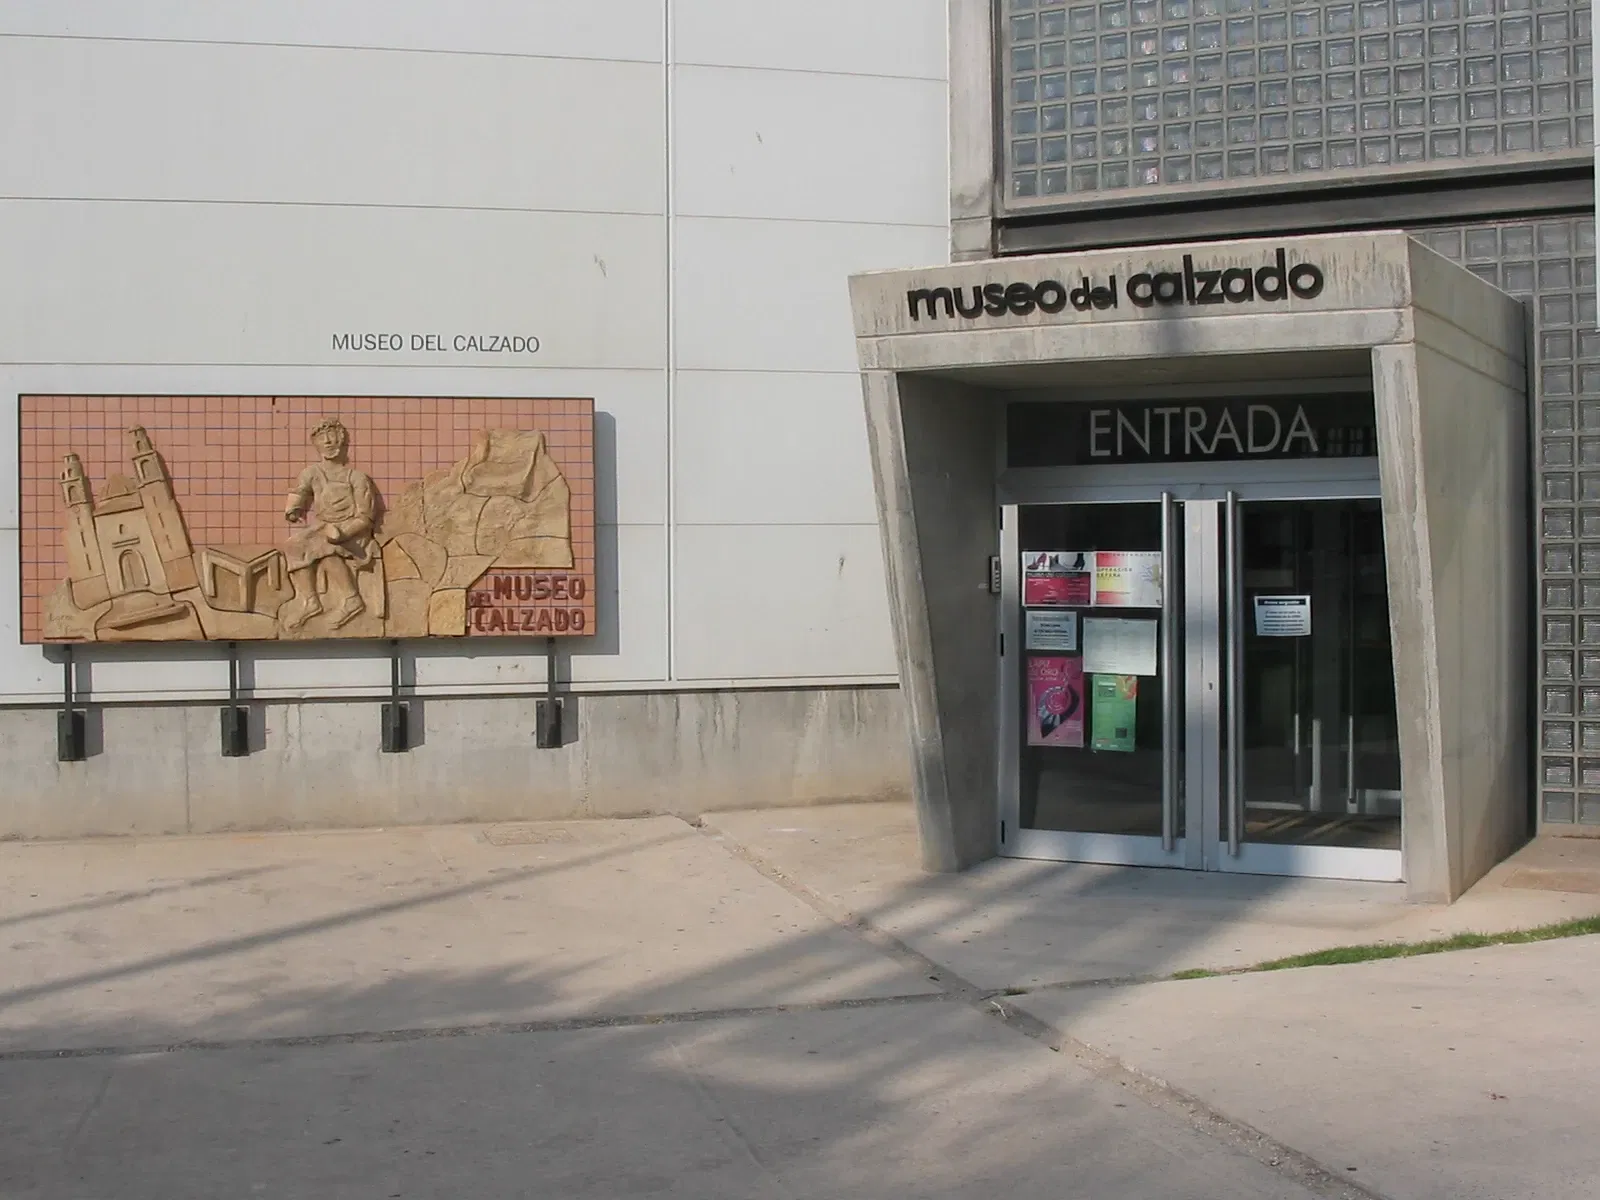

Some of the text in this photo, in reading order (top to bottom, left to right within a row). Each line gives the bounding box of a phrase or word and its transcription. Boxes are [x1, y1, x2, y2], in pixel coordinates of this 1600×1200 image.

[907, 247, 1325, 322] museo del calzado
[332, 333, 540, 353] MUSEO DEL CALZADO
[1090, 404, 1319, 457] ENTRADA
[493, 575, 586, 601] MUSEO
[475, 608, 586, 632] CALZADO
